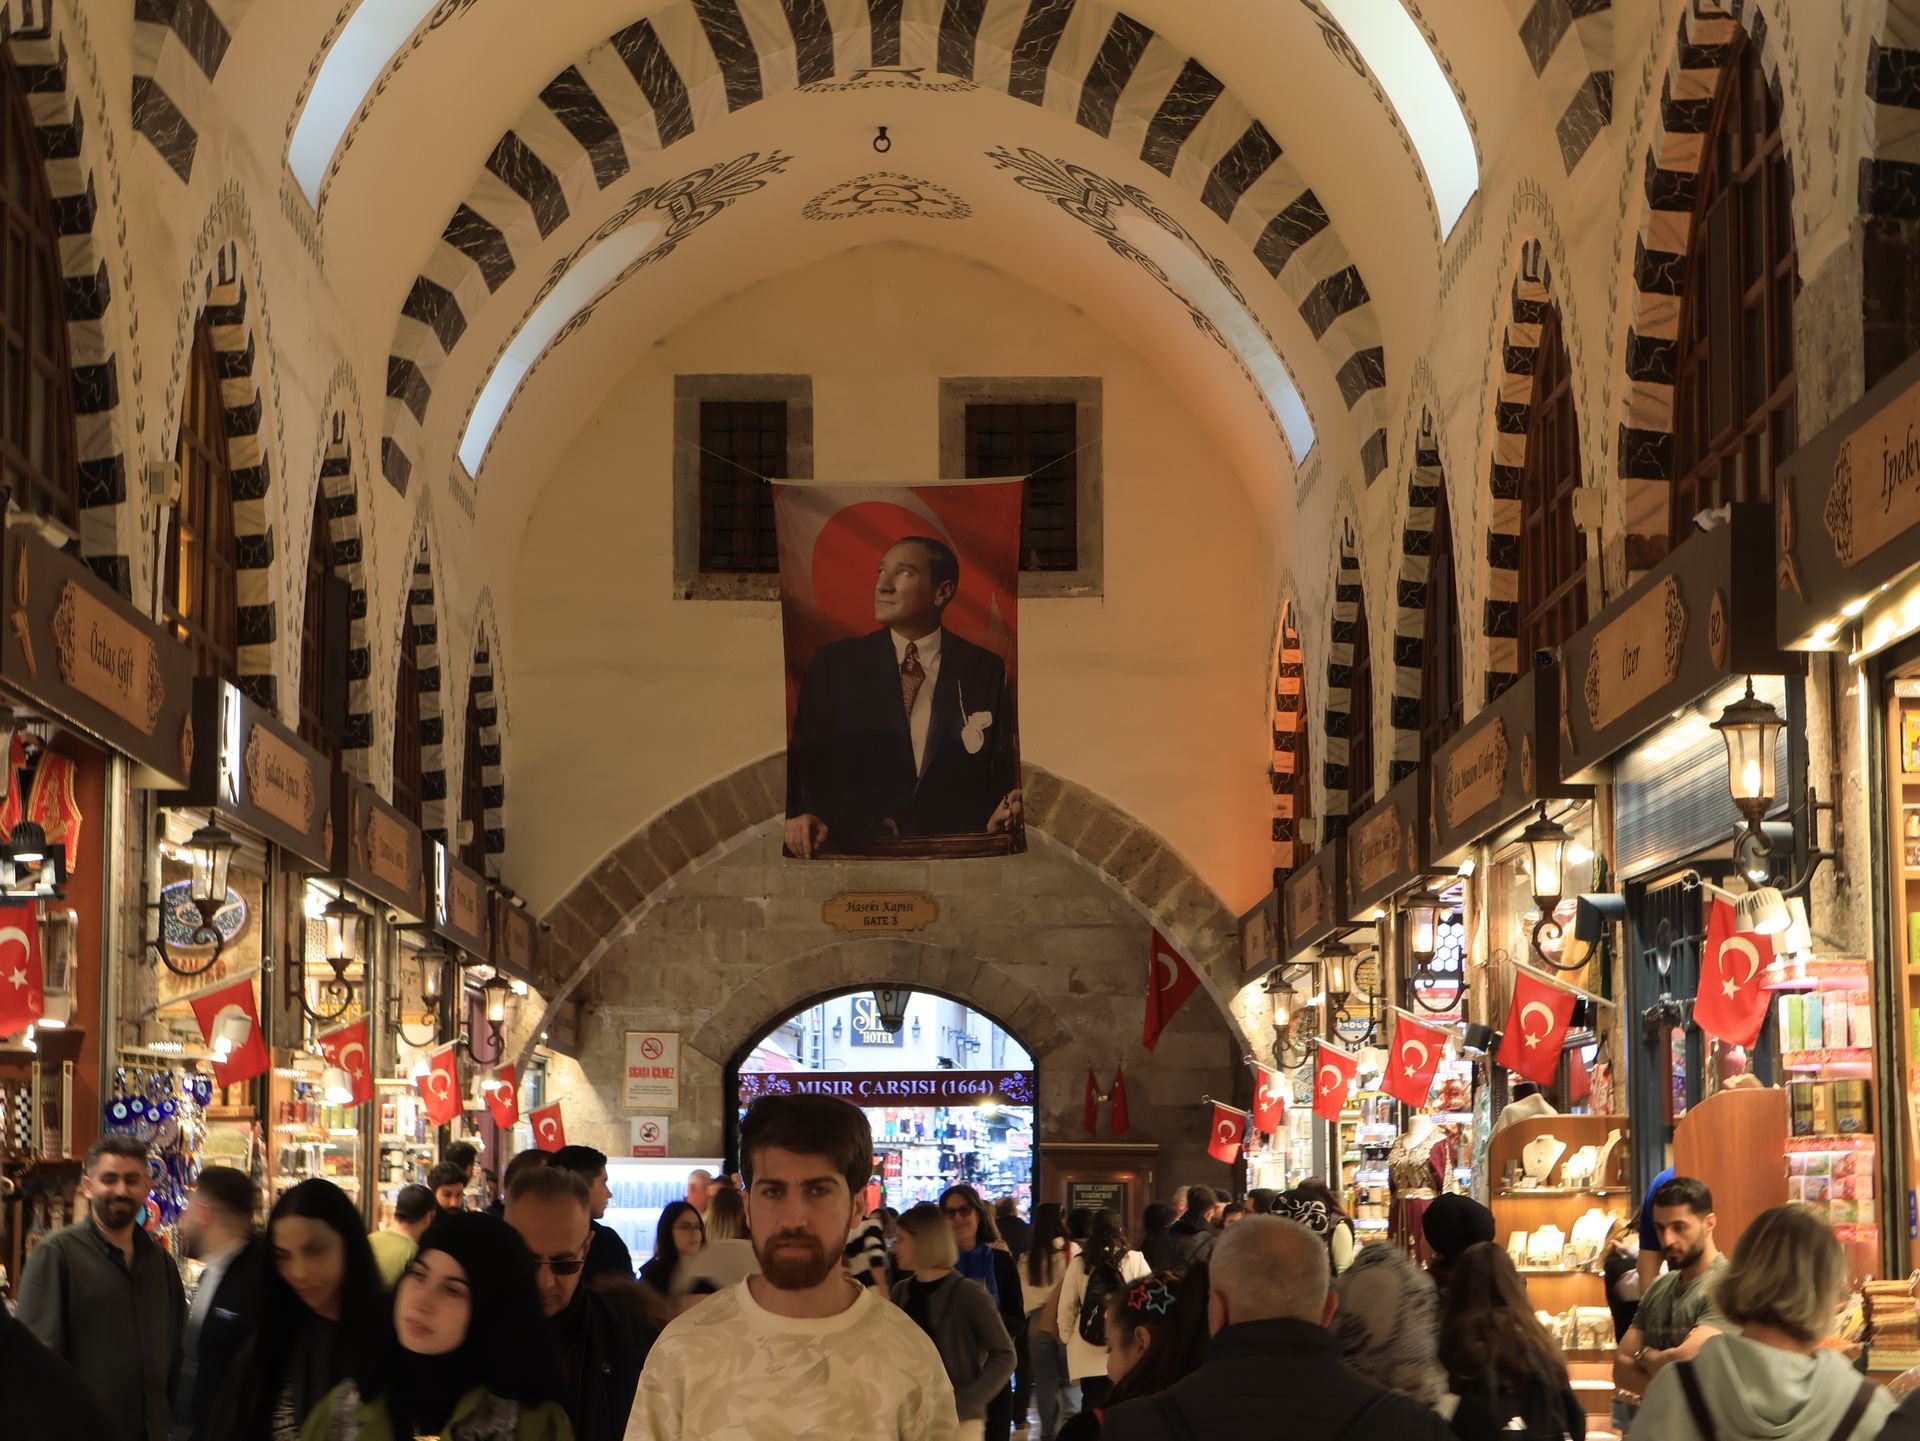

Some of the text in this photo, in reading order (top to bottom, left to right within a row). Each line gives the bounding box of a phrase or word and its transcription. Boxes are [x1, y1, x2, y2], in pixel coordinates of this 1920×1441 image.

[1711, 611, 1720, 646] 82
[90, 620, 134, 698] Öztaş Gift
[863, 916, 898, 926] GATE 3
[863, 1031, 895, 1044] HOTEL
[797, 1080, 994, 1097] MISIR ÇARŞISI (1664)
